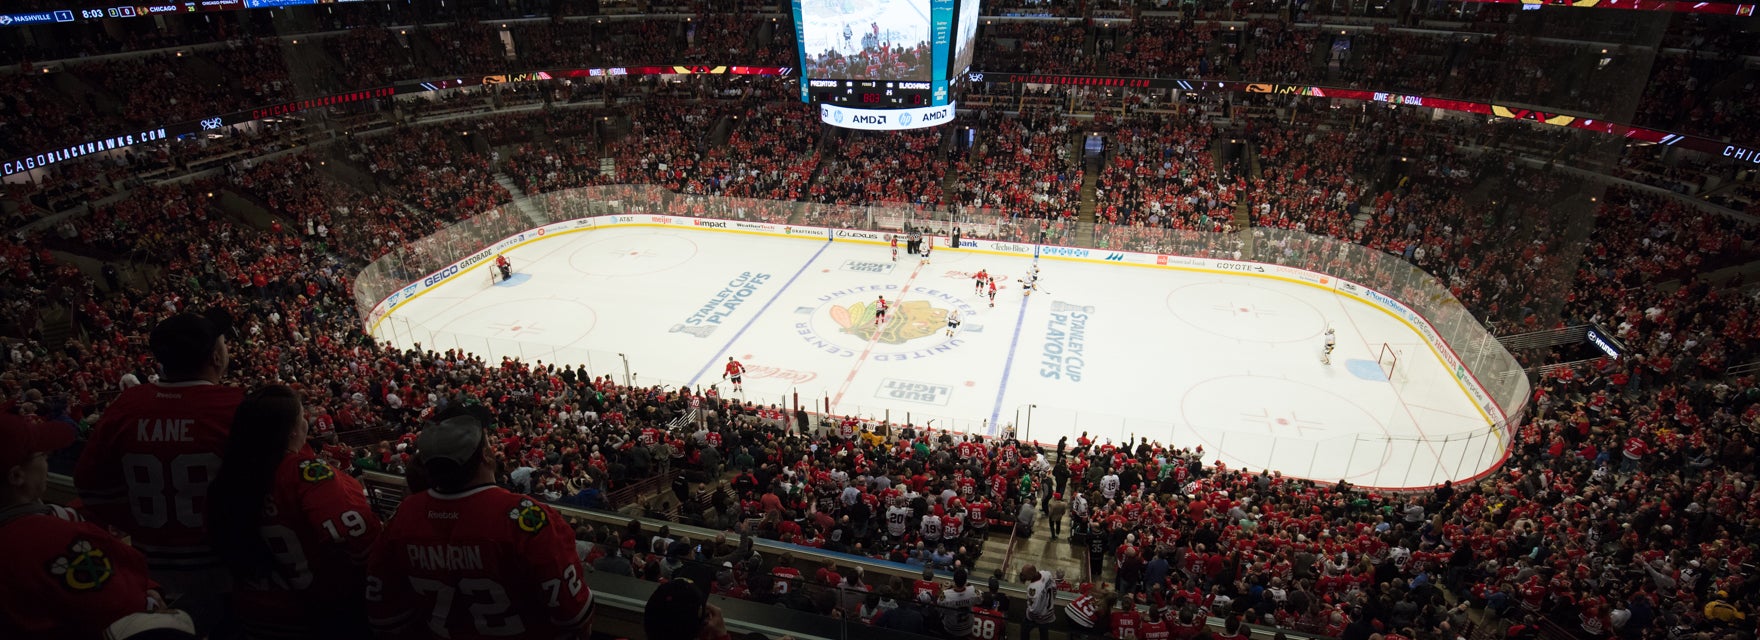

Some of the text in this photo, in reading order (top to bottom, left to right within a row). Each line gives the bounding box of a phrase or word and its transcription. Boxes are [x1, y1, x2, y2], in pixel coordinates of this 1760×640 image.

[13, 13, 51, 22] NASHVILLE
[82, 8, 104, 19] 8:03
[149, 5, 177, 13] CHICAGO
[589, 68, 601, 76] ONE
[810, 80, 838, 88] PREDATORS
[898, 82, 931, 90] BLACKHAWKS
[1373, 92, 1423, 106] ONE GOAL
[852, 114, 877, 124] AMD
[922, 111, 942, 122] AMD
[651, 216, 672, 225] meijer
[699, 219, 727, 229] impact
[736, 222, 776, 230] WeatherTech
[496, 237, 518, 251] UNITED
[460, 248, 493, 269] GATORADE
[1216, 262, 1252, 272] COYOTE
[424, 265, 458, 288] GEICO
[685, 271, 752, 325] STANLEY CUP
[706, 273, 772, 324] PLAYOFFS
[817, 284, 977, 316] UNITED CENTER
[1370, 291, 1407, 313] NorthShore
[795, 321, 966, 362] UNITED CENTER
[1040, 312, 1068, 380] PLAYOFFS
[1065, 312, 1088, 382] STANLEY CUP
[1595, 337, 1619, 360] HYUNDAI
[1434, 339, 1457, 371] HONDA
[883, 380, 948, 396] LIGHT
[890, 389, 937, 403] BUD
[136, 418, 196, 442] KANE
[121, 452, 223, 529] 88
[427, 510, 459, 520] Reebok
[890, 512, 904, 524] 20
[322, 510, 367, 543] 19
[406, 544, 484, 571] PANARIN
[541, 564, 583, 608] 72
[407, 575, 527, 640] 72
[971, 617, 996, 640] 88
